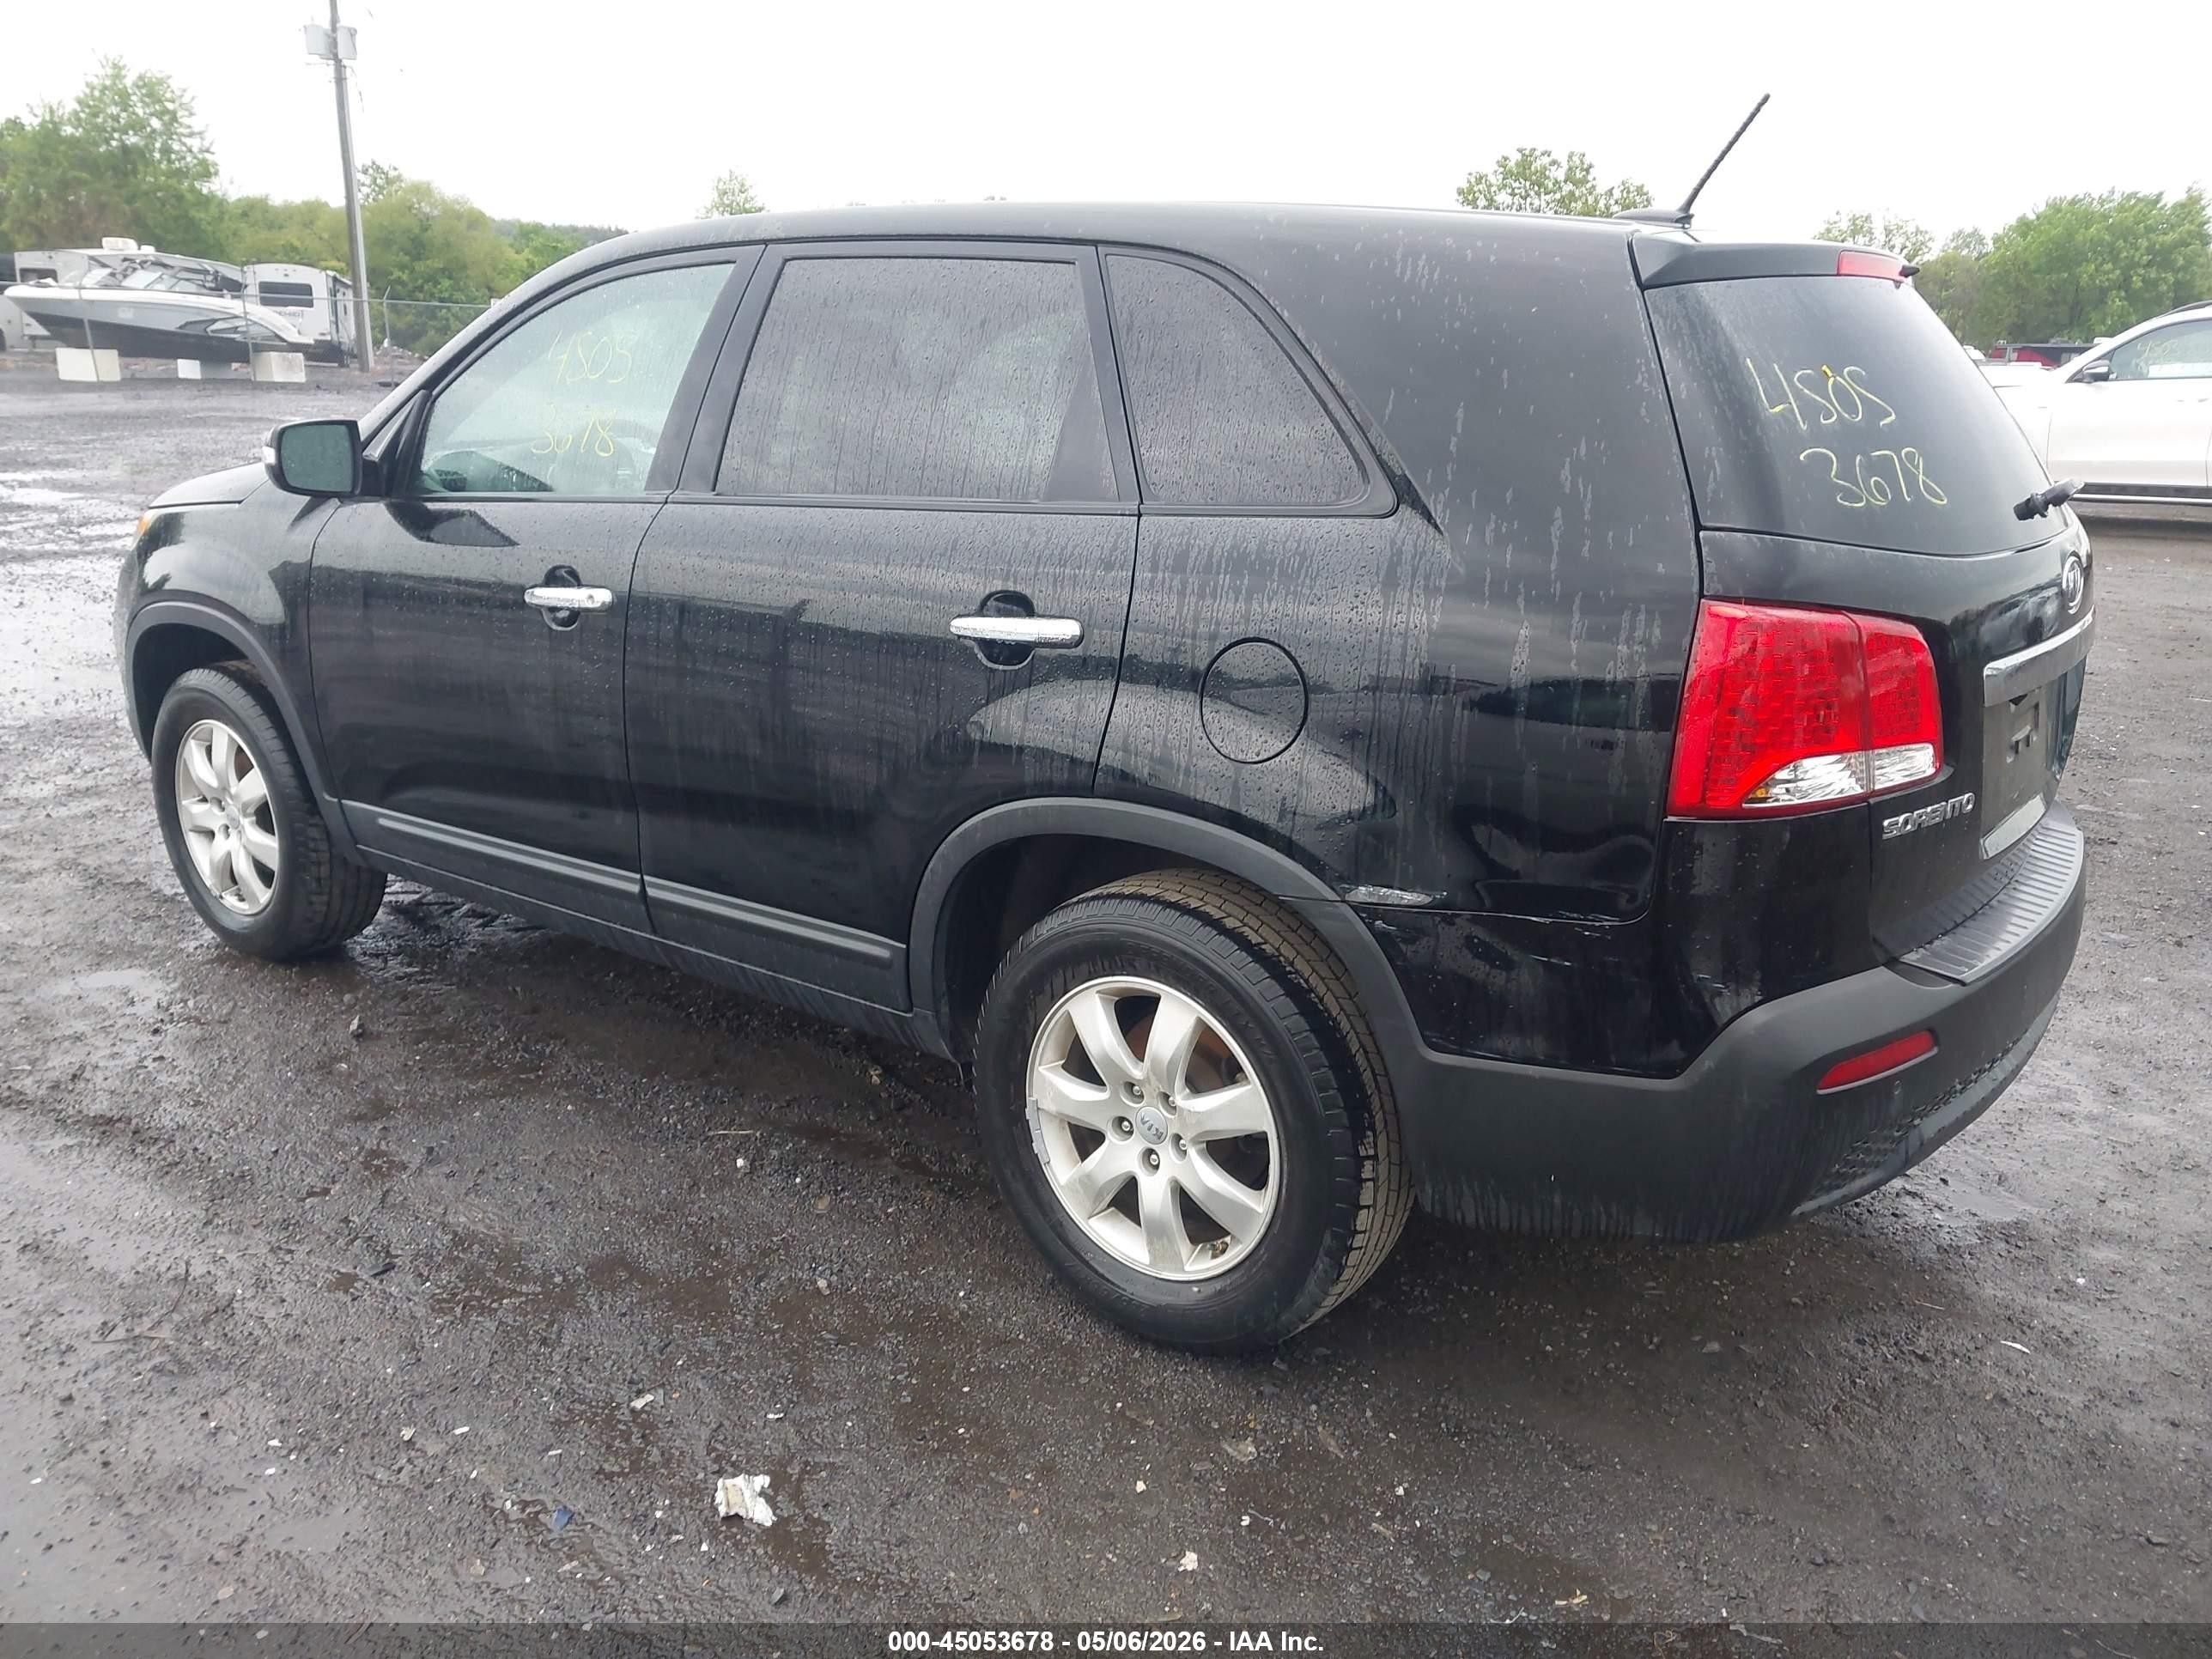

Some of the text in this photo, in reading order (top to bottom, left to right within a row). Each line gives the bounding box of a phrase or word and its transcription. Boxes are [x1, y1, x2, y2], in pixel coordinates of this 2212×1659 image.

[1745, 357, 1897, 430] 4505
[1799, 446, 1948, 507] 3678
[1881, 792, 1976, 840] SORENTO
[1139, 1112, 1164, 1141] KIA
